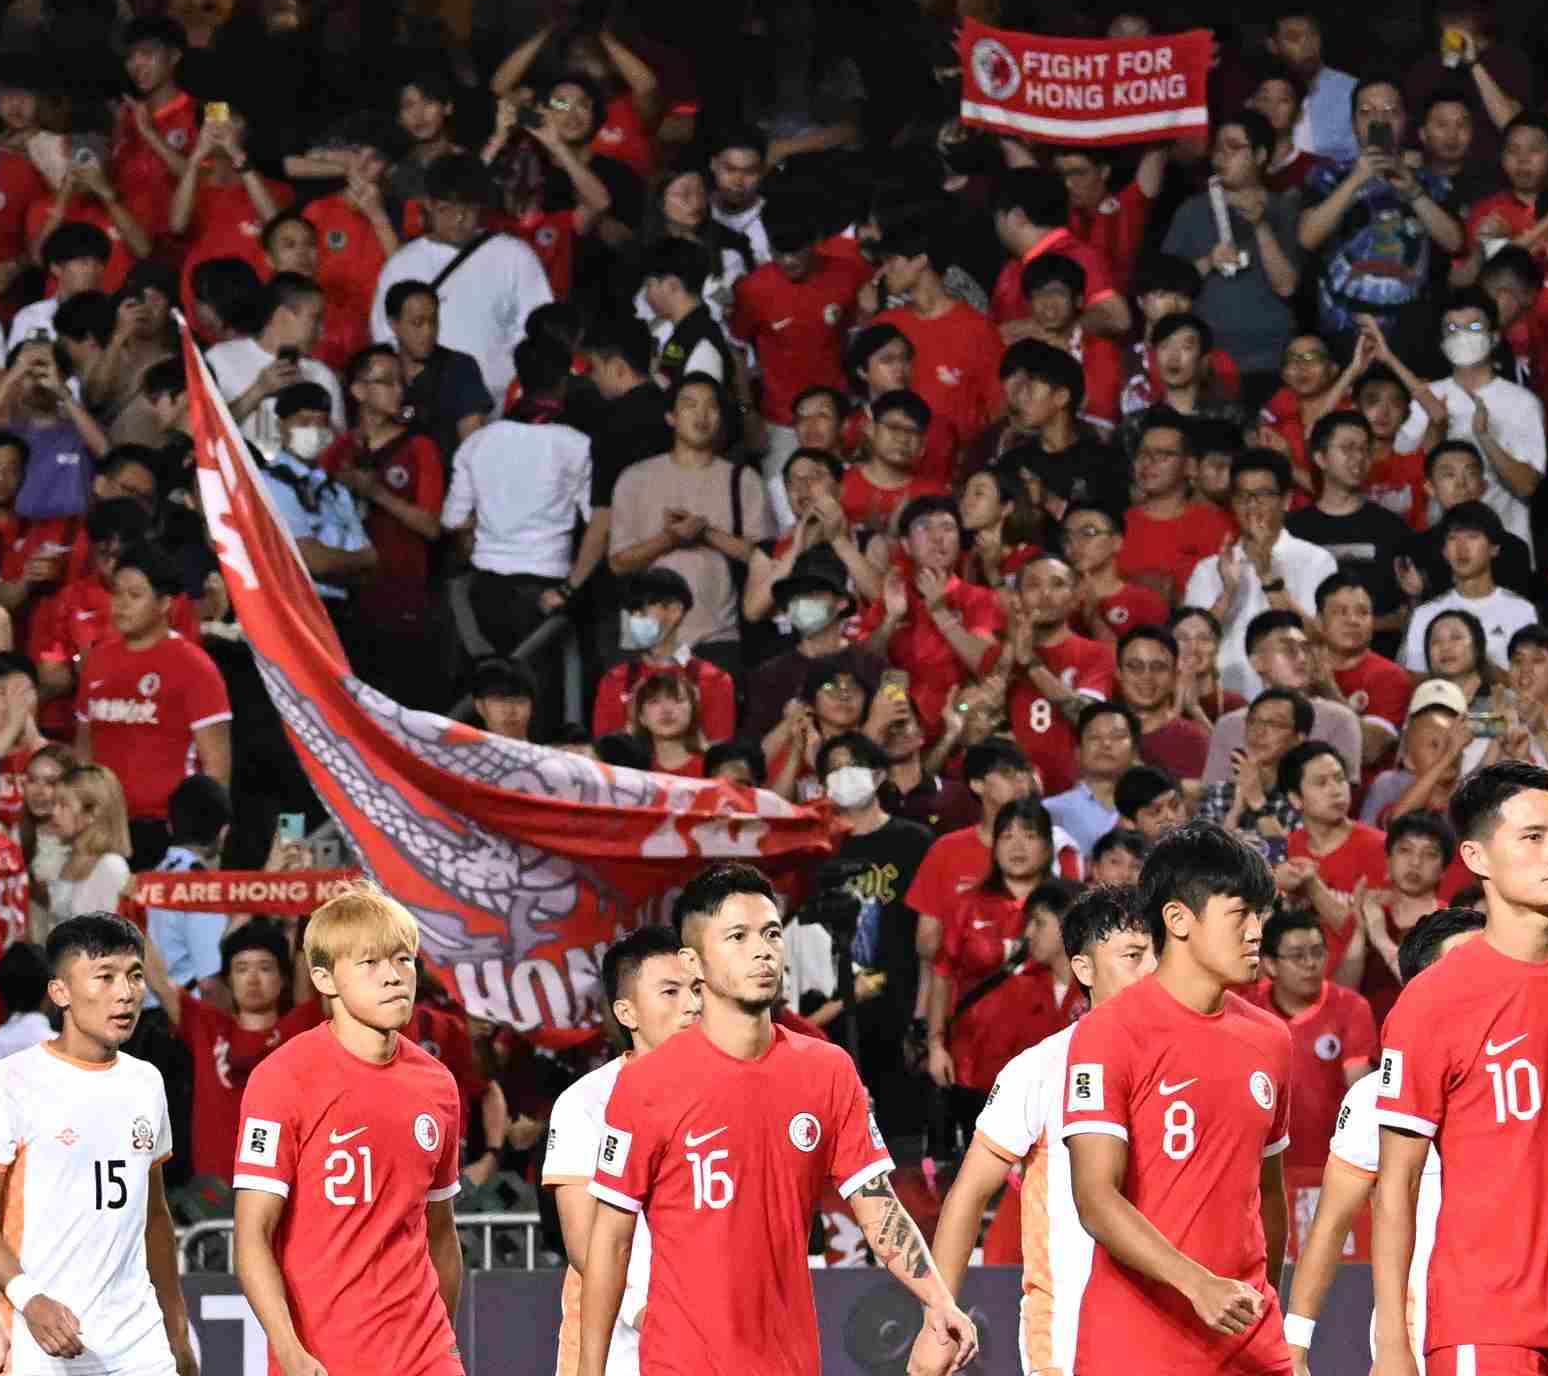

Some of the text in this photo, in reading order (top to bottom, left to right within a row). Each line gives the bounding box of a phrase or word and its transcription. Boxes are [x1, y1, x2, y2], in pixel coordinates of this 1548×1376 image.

[1023, 47, 1173, 81] FIGHT FOR
[1024, 73, 1185, 111] HONG KONG
[1030, 698, 1051, 733] 8
[170, 881, 223, 903] ARE
[227, 881, 310, 903] HONG
[1486, 1062, 1541, 1123] 10
[1163, 1101, 1194, 1159] 8
[95, 1160, 127, 1209] 15
[325, 1140, 372, 1205] 21
[686, 1150, 733, 1209] 16
